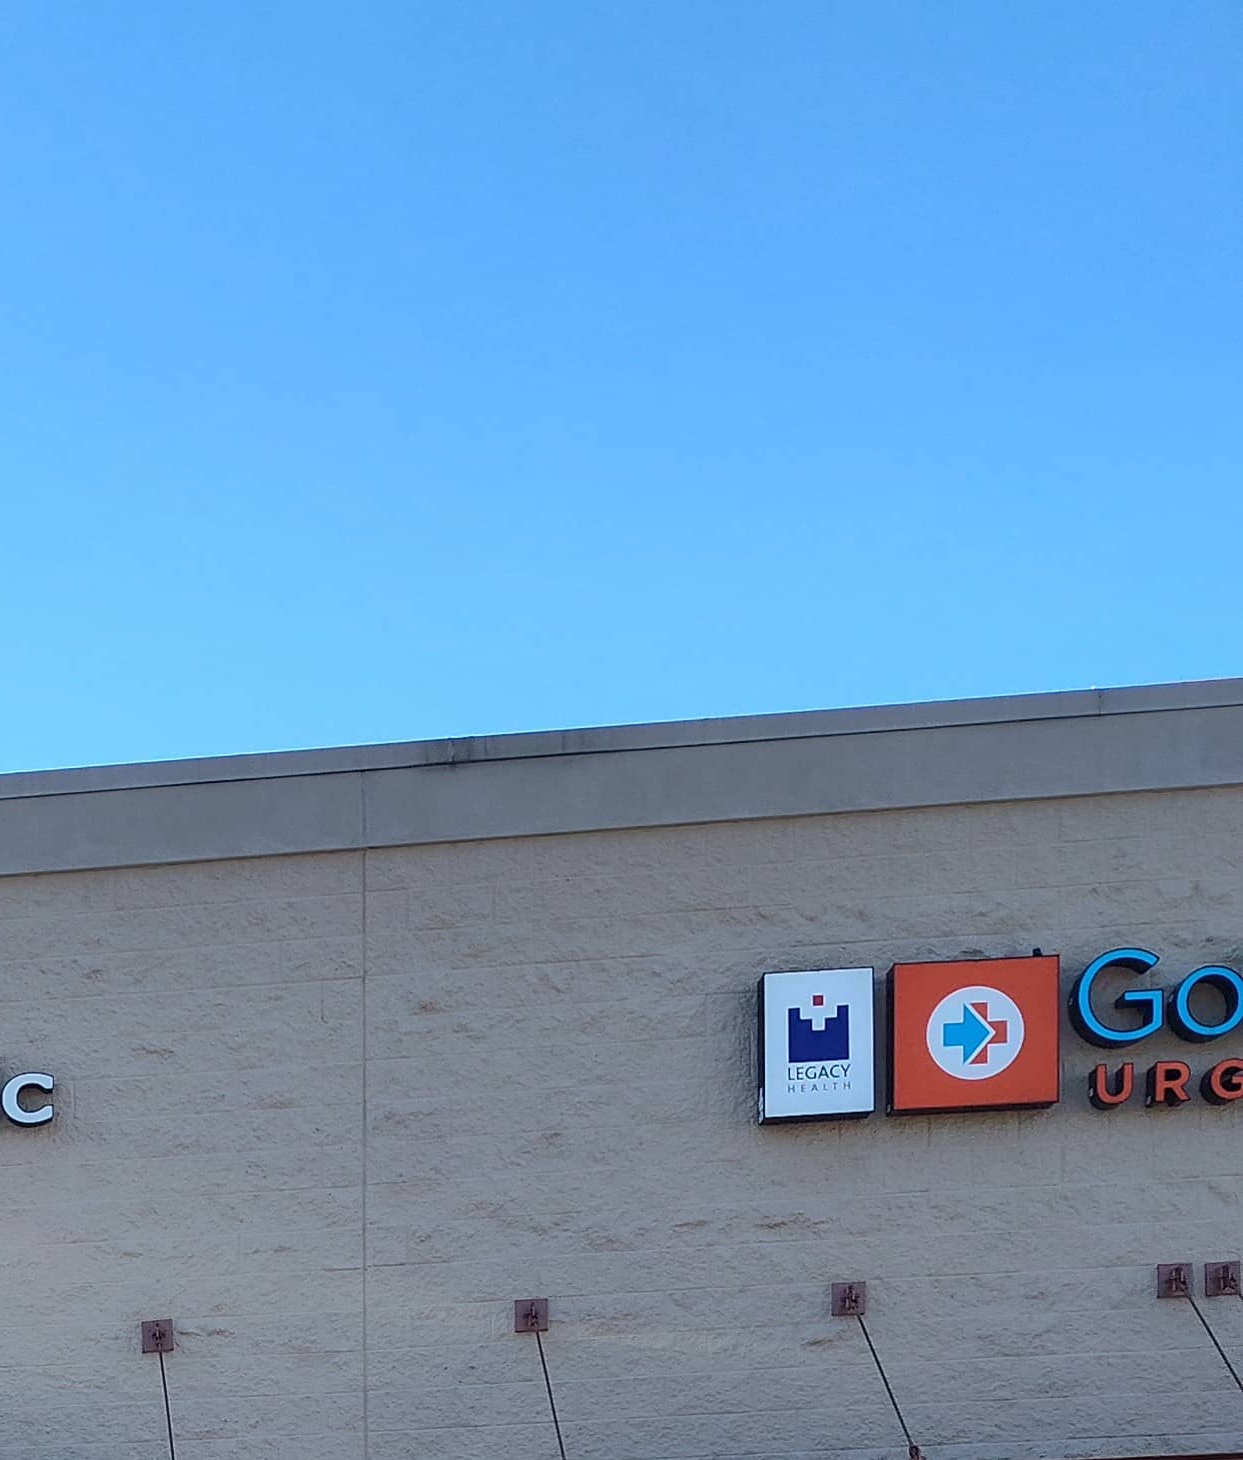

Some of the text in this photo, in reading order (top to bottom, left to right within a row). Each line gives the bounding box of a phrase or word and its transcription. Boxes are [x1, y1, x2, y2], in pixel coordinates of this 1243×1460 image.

[1078, 946, 1243, 1041] Go
[787, 1063, 852, 1081] LEGACY
[787, 1081, 851, 1094] HEALTH
[1094, 1057, 1243, 1106] URG
